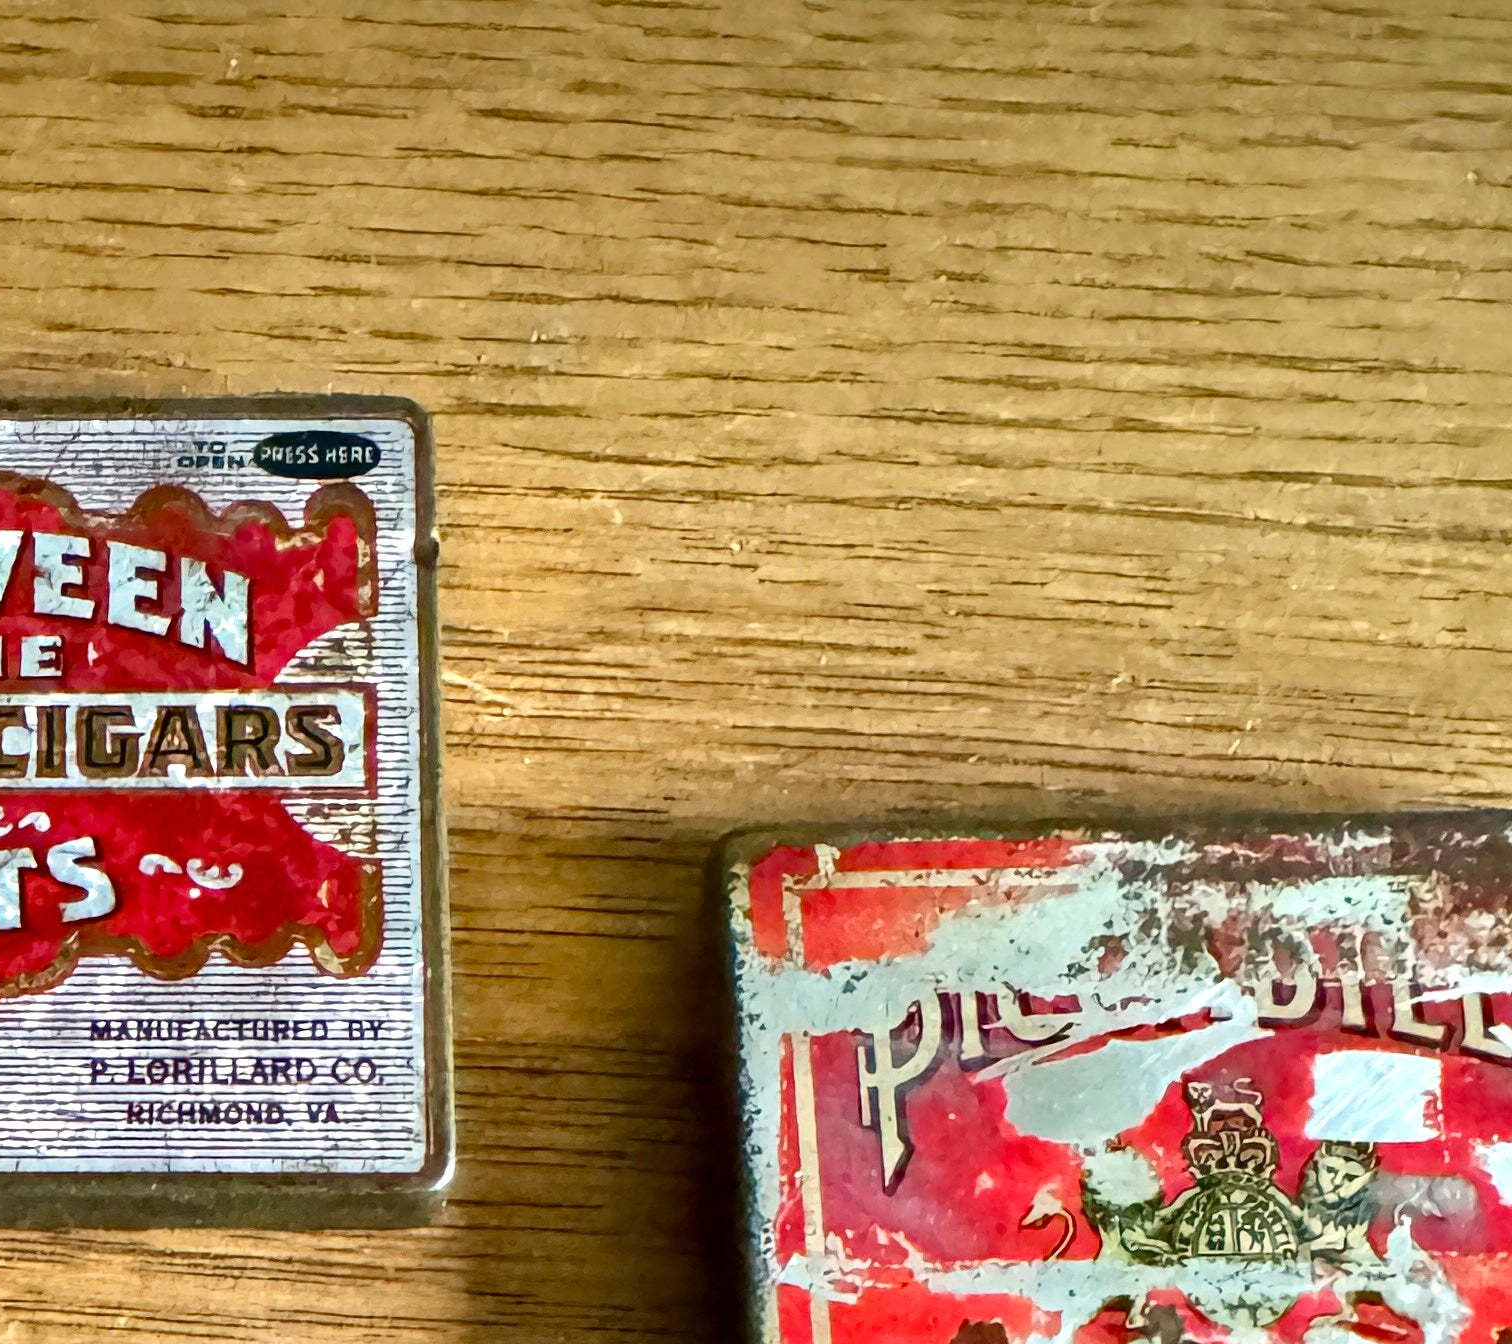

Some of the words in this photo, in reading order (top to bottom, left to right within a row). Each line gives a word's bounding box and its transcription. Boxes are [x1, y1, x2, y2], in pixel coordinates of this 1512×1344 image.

[192, 441, 226, 453] TO
[260, 443, 321, 465] PRESS
[325, 445, 375, 464] HERE
[176, 456, 245, 470] OPEN
[89, 1019, 329, 1041] MANUFACTURED
[347, 1019, 384, 1040] BY
[127, 1057, 318, 1085] LORILLARD
